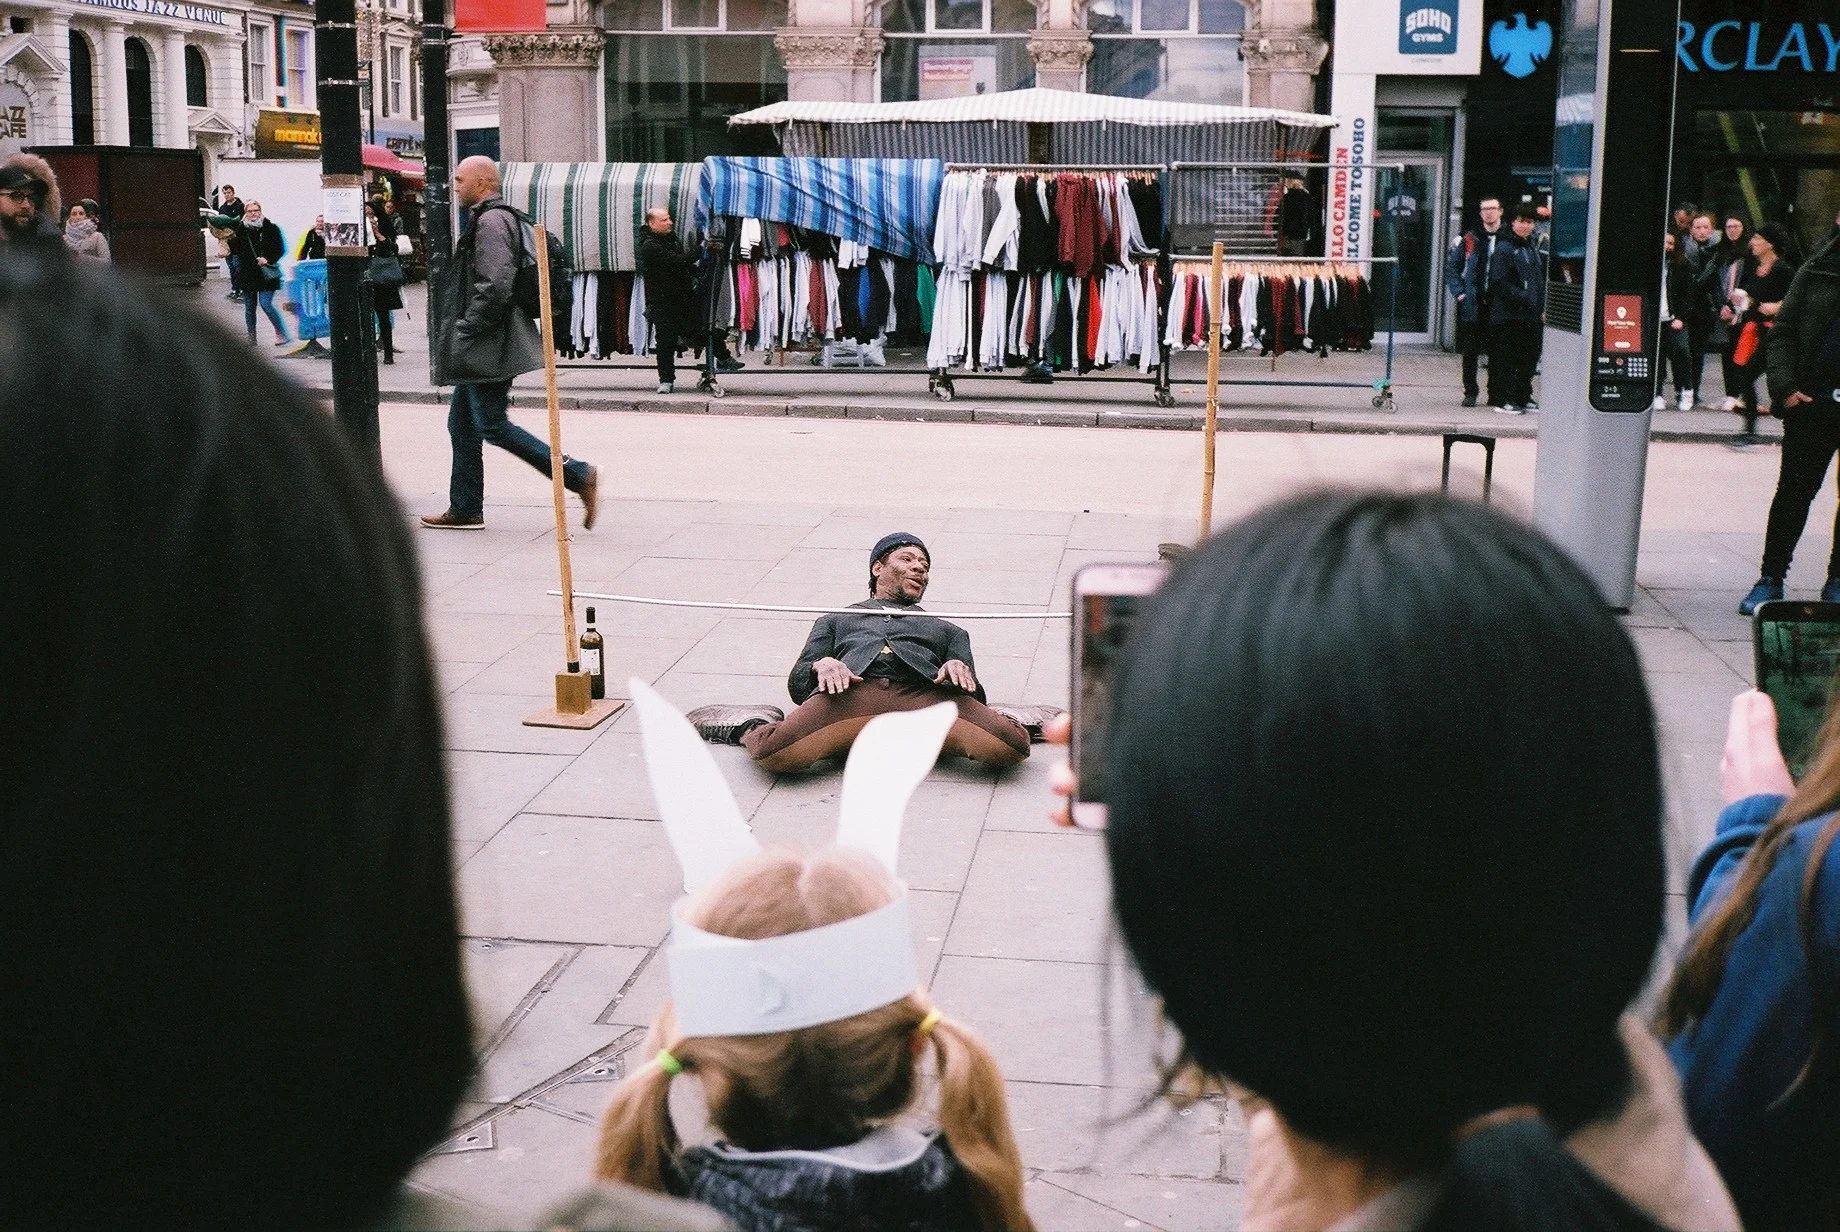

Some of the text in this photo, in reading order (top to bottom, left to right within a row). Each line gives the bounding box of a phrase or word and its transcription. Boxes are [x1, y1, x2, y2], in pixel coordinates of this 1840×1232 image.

[145, 0, 182, 18] JAZZ
[186, 6, 229, 26] VENUE
[1406, 8, 1451, 35] SOHO
[1412, 33, 1444, 42] GYMS
[1352, 117, 1365, 165] SOHO
[1351, 166, 1363, 191] TO
[1331, 147, 1348, 264] LLO CAMDEN
